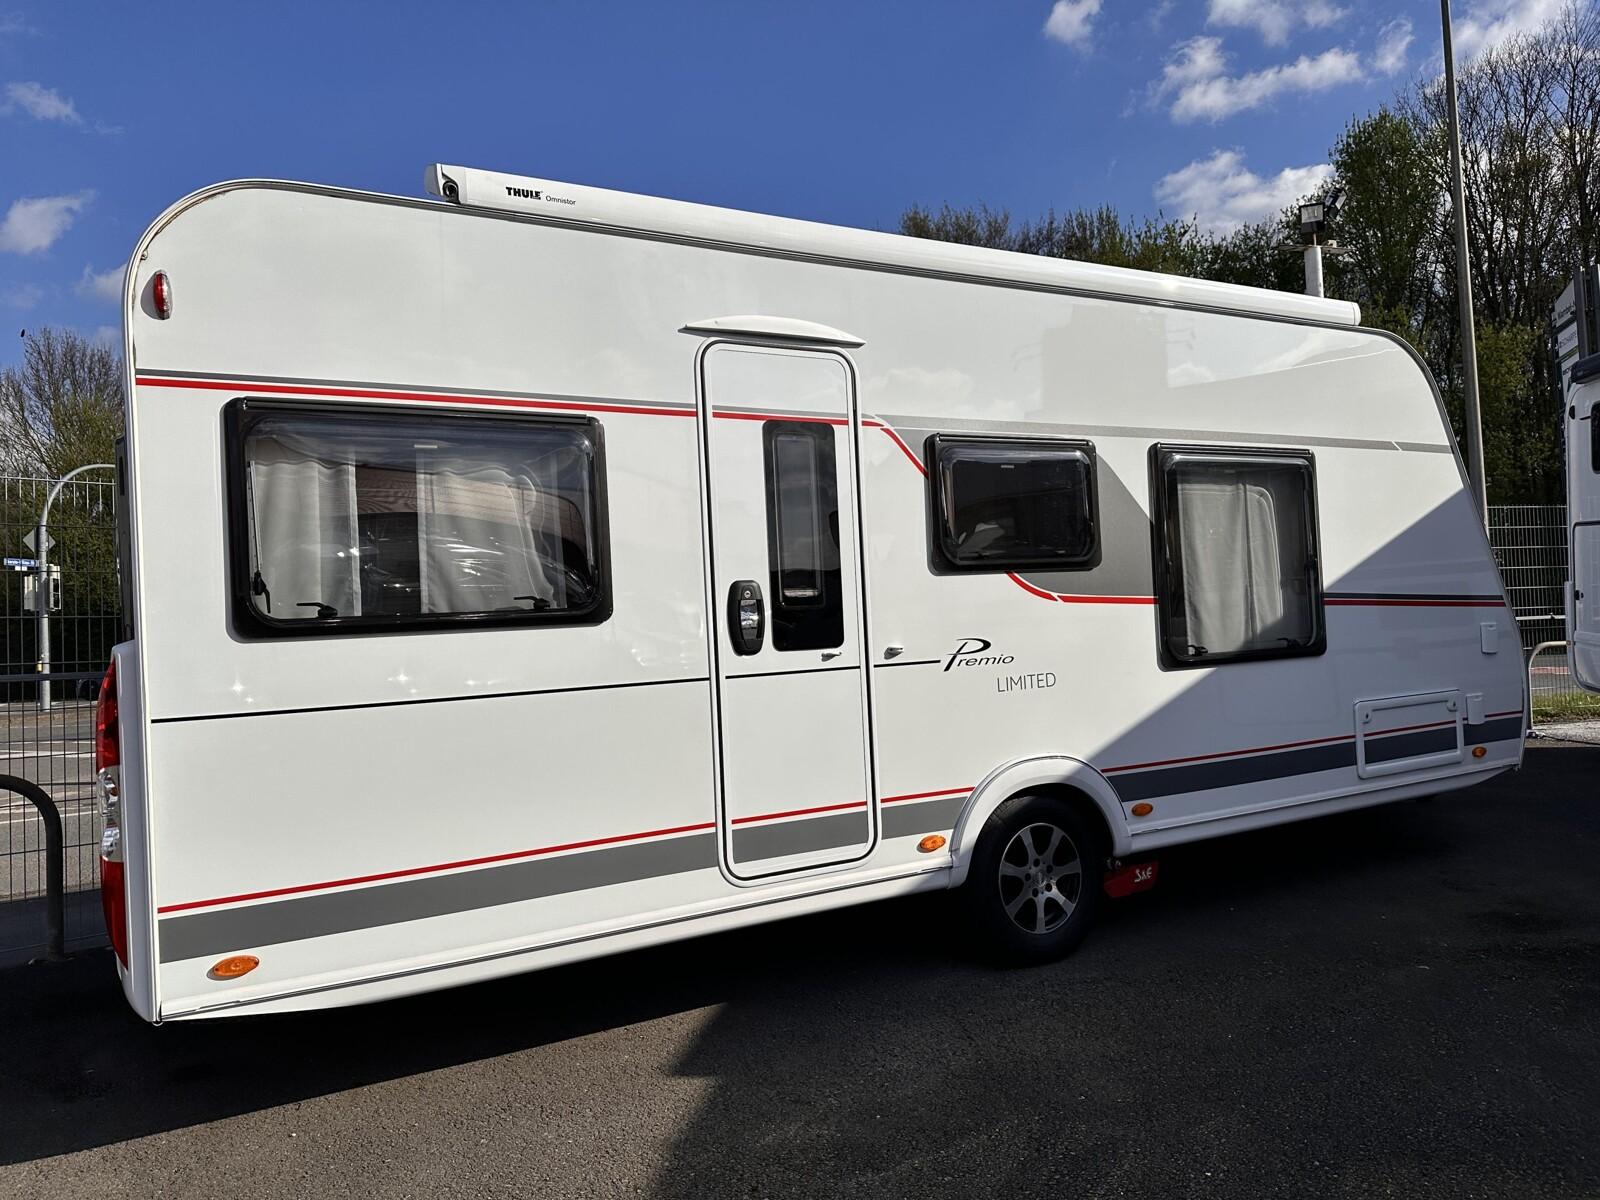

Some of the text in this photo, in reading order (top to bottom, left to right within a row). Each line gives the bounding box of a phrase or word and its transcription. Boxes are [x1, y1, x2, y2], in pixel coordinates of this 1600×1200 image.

[505, 186, 576, 205] THULE Omnistor
[943, 638, 1014, 672] Premio
[997, 672, 1056, 692] LIMITED
